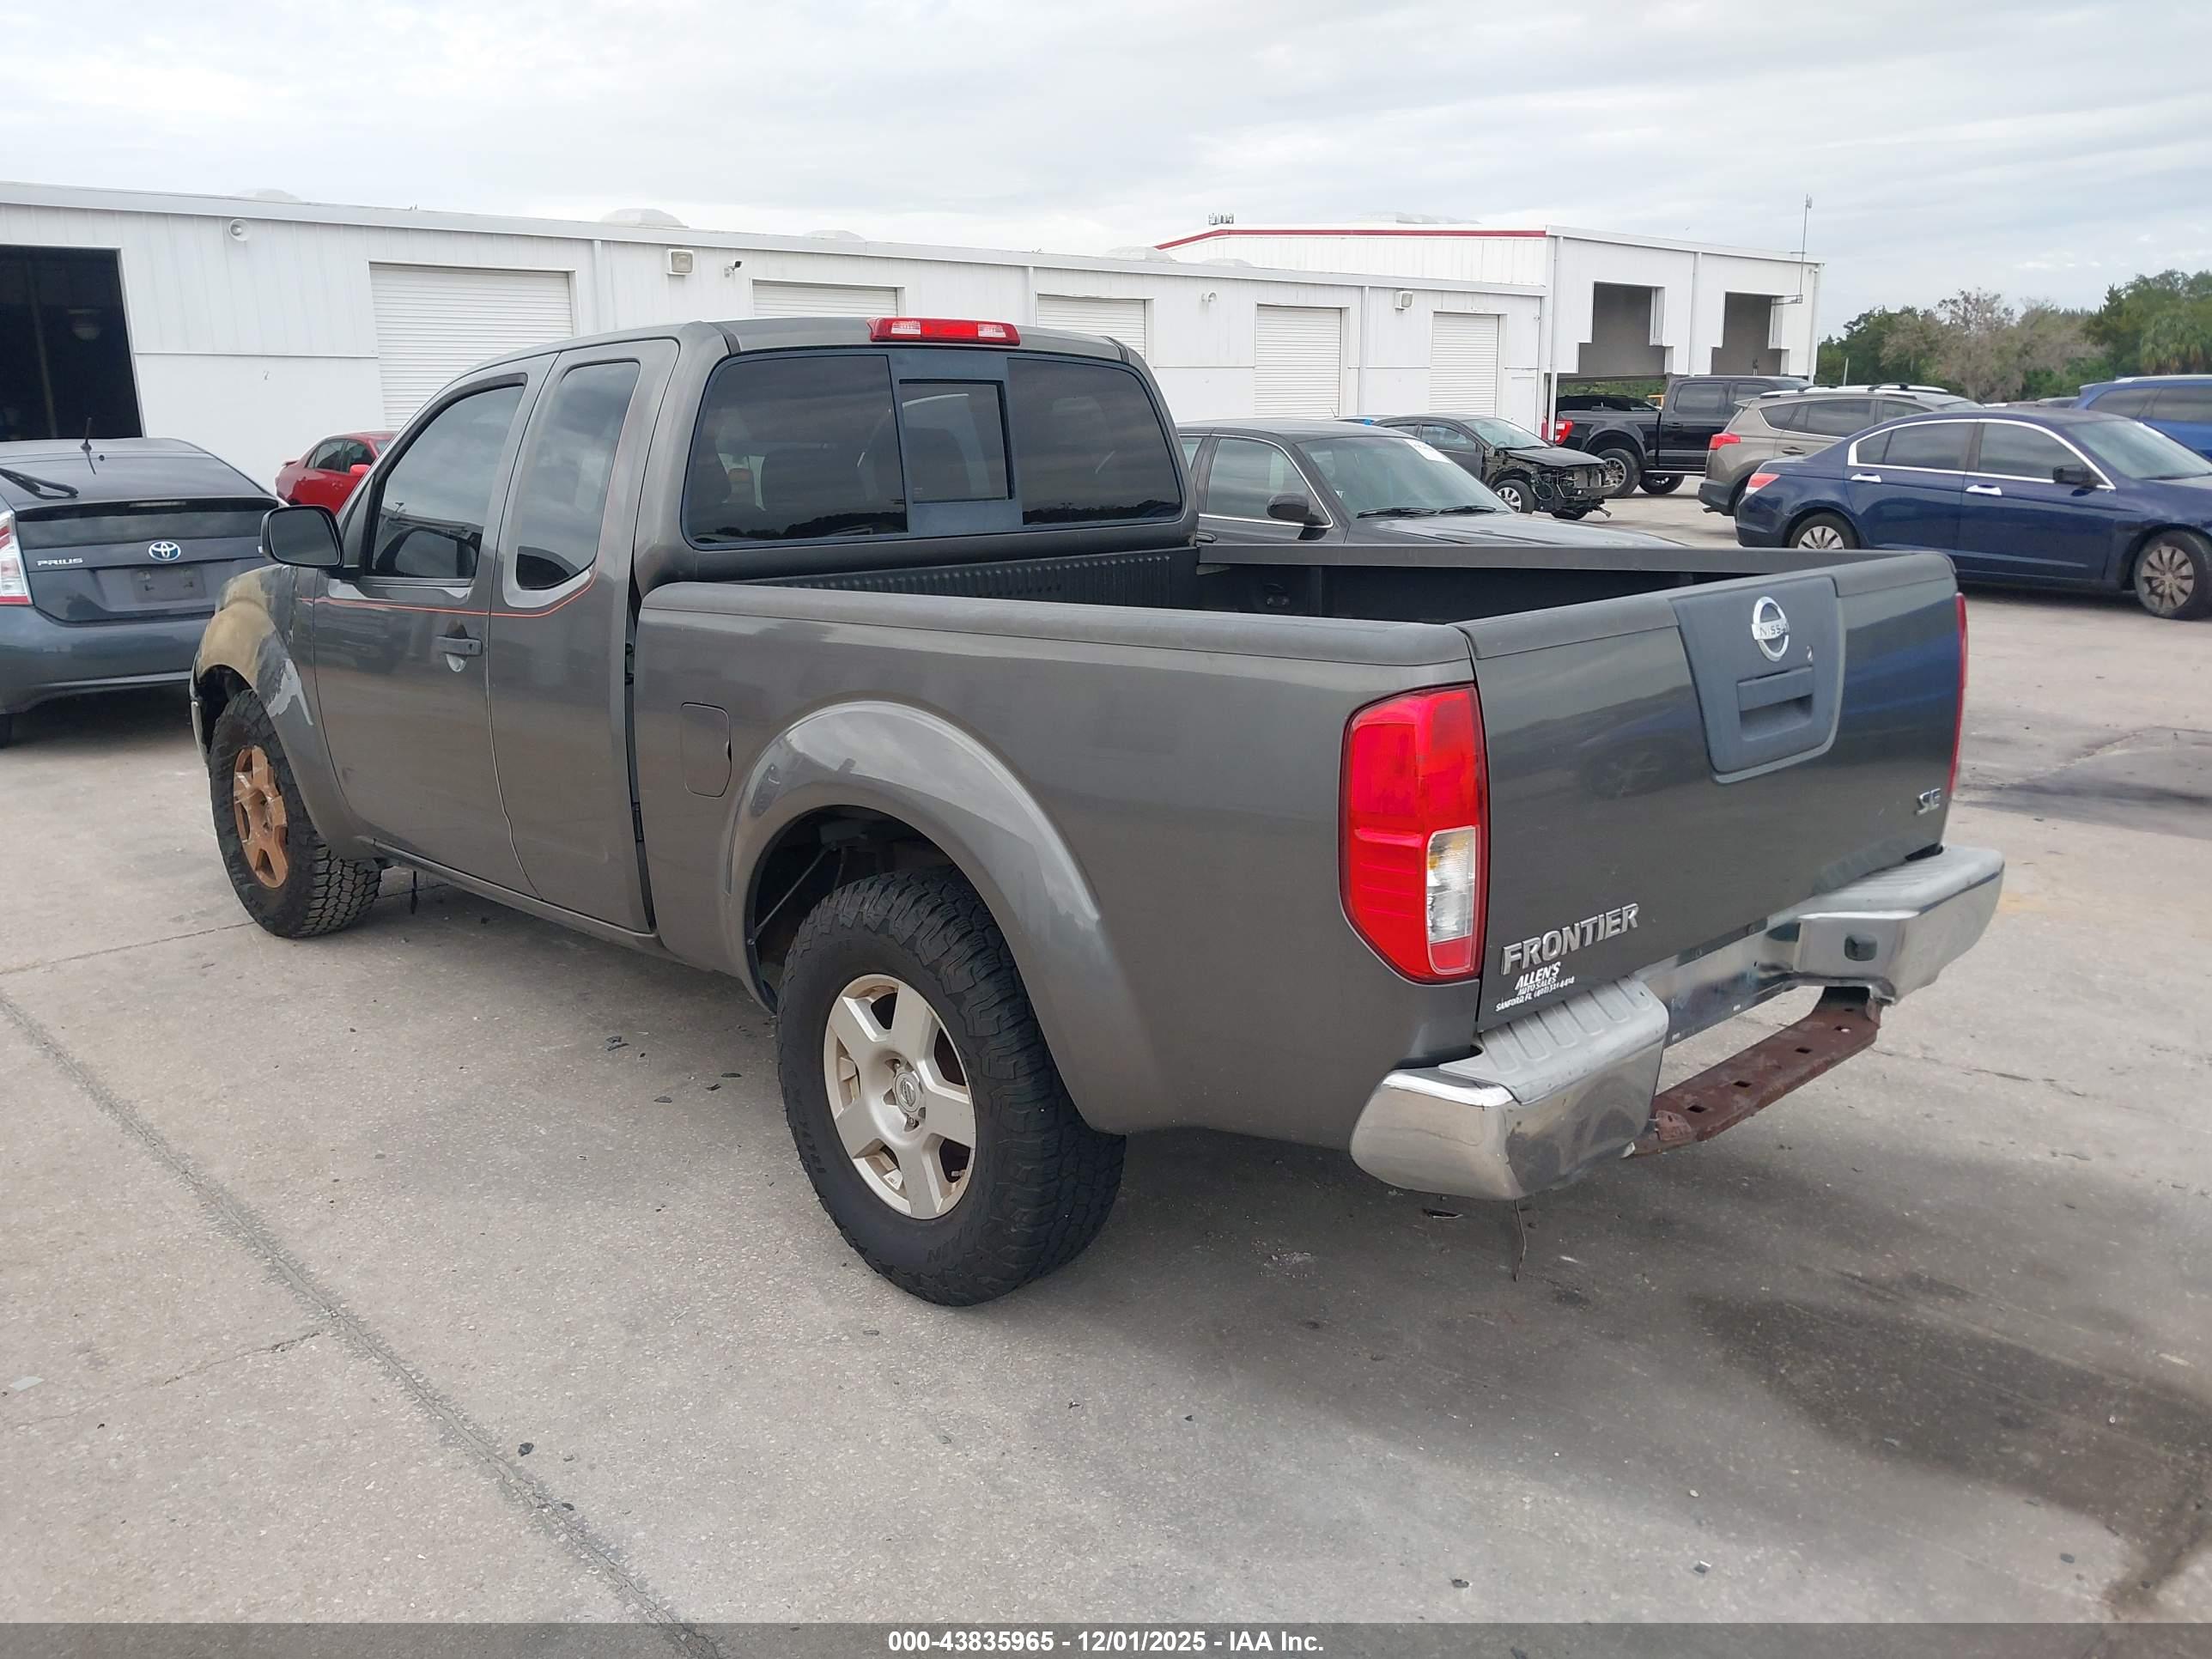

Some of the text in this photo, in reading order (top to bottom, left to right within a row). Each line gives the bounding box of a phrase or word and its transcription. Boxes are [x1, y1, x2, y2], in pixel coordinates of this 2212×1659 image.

[37, 557, 83, 567] PRIUS
[1917, 787, 1941, 816] SE
[1501, 902, 1639, 975] FRONTIER
[1514, 961, 1562, 991] ALLEN'S
[1516, 975, 1557, 997] AUTO SALES
